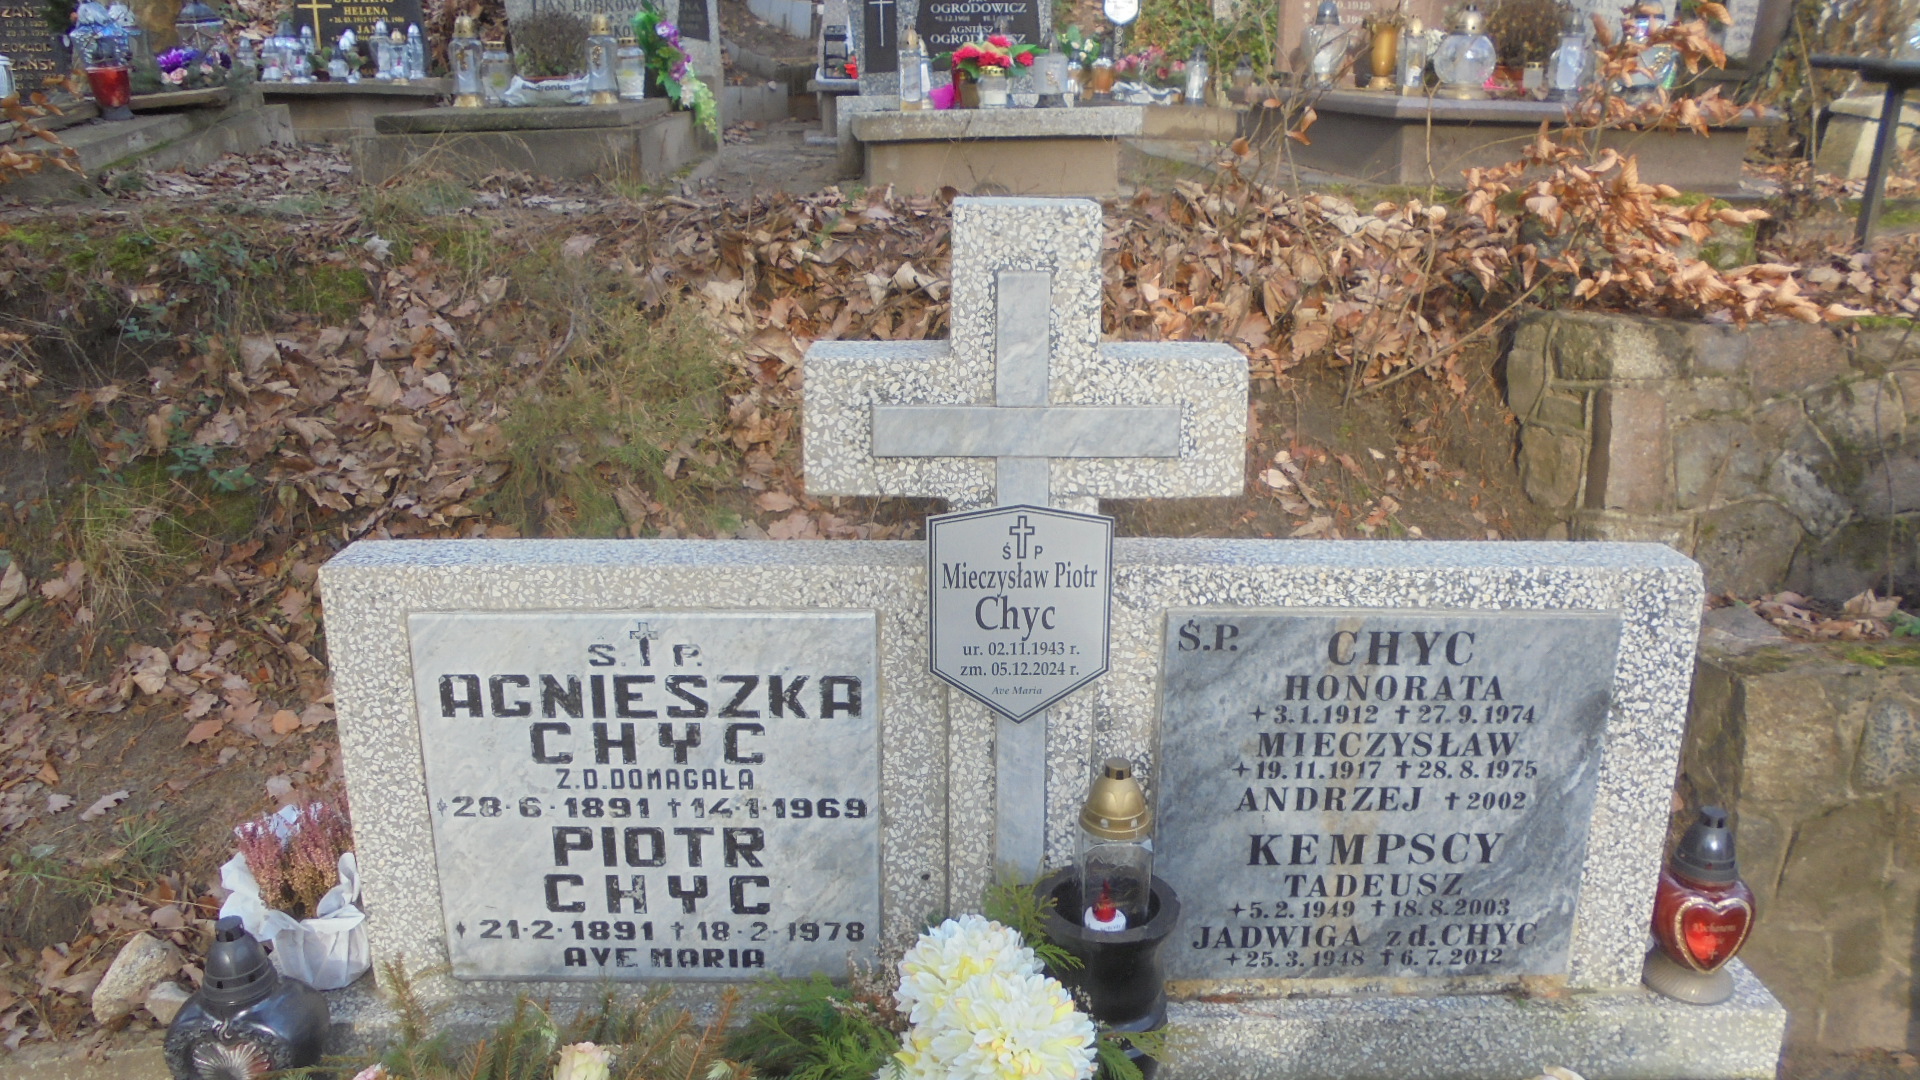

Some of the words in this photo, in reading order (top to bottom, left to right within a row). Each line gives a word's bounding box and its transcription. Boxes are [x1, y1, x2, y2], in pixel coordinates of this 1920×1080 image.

[344, 6, 388, 15] HELENA
[573, 0, 666, 13] BORKOWKI
[930, 2, 1027, 13] OGRODOWICZ
[1002, 541, 1012, 560] Ś
[1034, 545, 1044, 560] P
[942, 561, 1049, 598] Mieczysław
[1054, 561, 1098, 589] Piotr
[975, 595, 1056, 642] Chyc
[962, 645, 983, 656] ur.
[988, 641, 1065, 656] 02.11.1943
[1069, 645, 1080, 656] r.
[1327, 630, 1476, 667] CHYC
[960, 663, 987, 677] zm.
[991, 662, 1066, 676] 05.12.2024
[1069, 664, 1080, 676] r.
[439, 674, 863, 720] AGNIESZKA
[992, 685, 1009, 695] Ave
[1012, 685, 1042, 695] Maria
[1283, 674, 1505, 702] HONORATA
[529, 721, 766, 766] CHYC
[1255, 731, 1520, 759] MIECZYSŁAW
[1233, 786, 1422, 813] ANDRZEJ
[1466, 791, 1527, 811] 2002
[552, 826, 765, 868] PIOTR
[1245, 832, 1505, 867] KEMPSCY
[543, 873, 771, 916] CHYC
[1283, 872, 1465, 898] TADEUSZ
[1191, 924, 1364, 951] JADWIGA
[563, 947, 639, 968] AVE
[650, 948, 765, 969] MARIA
